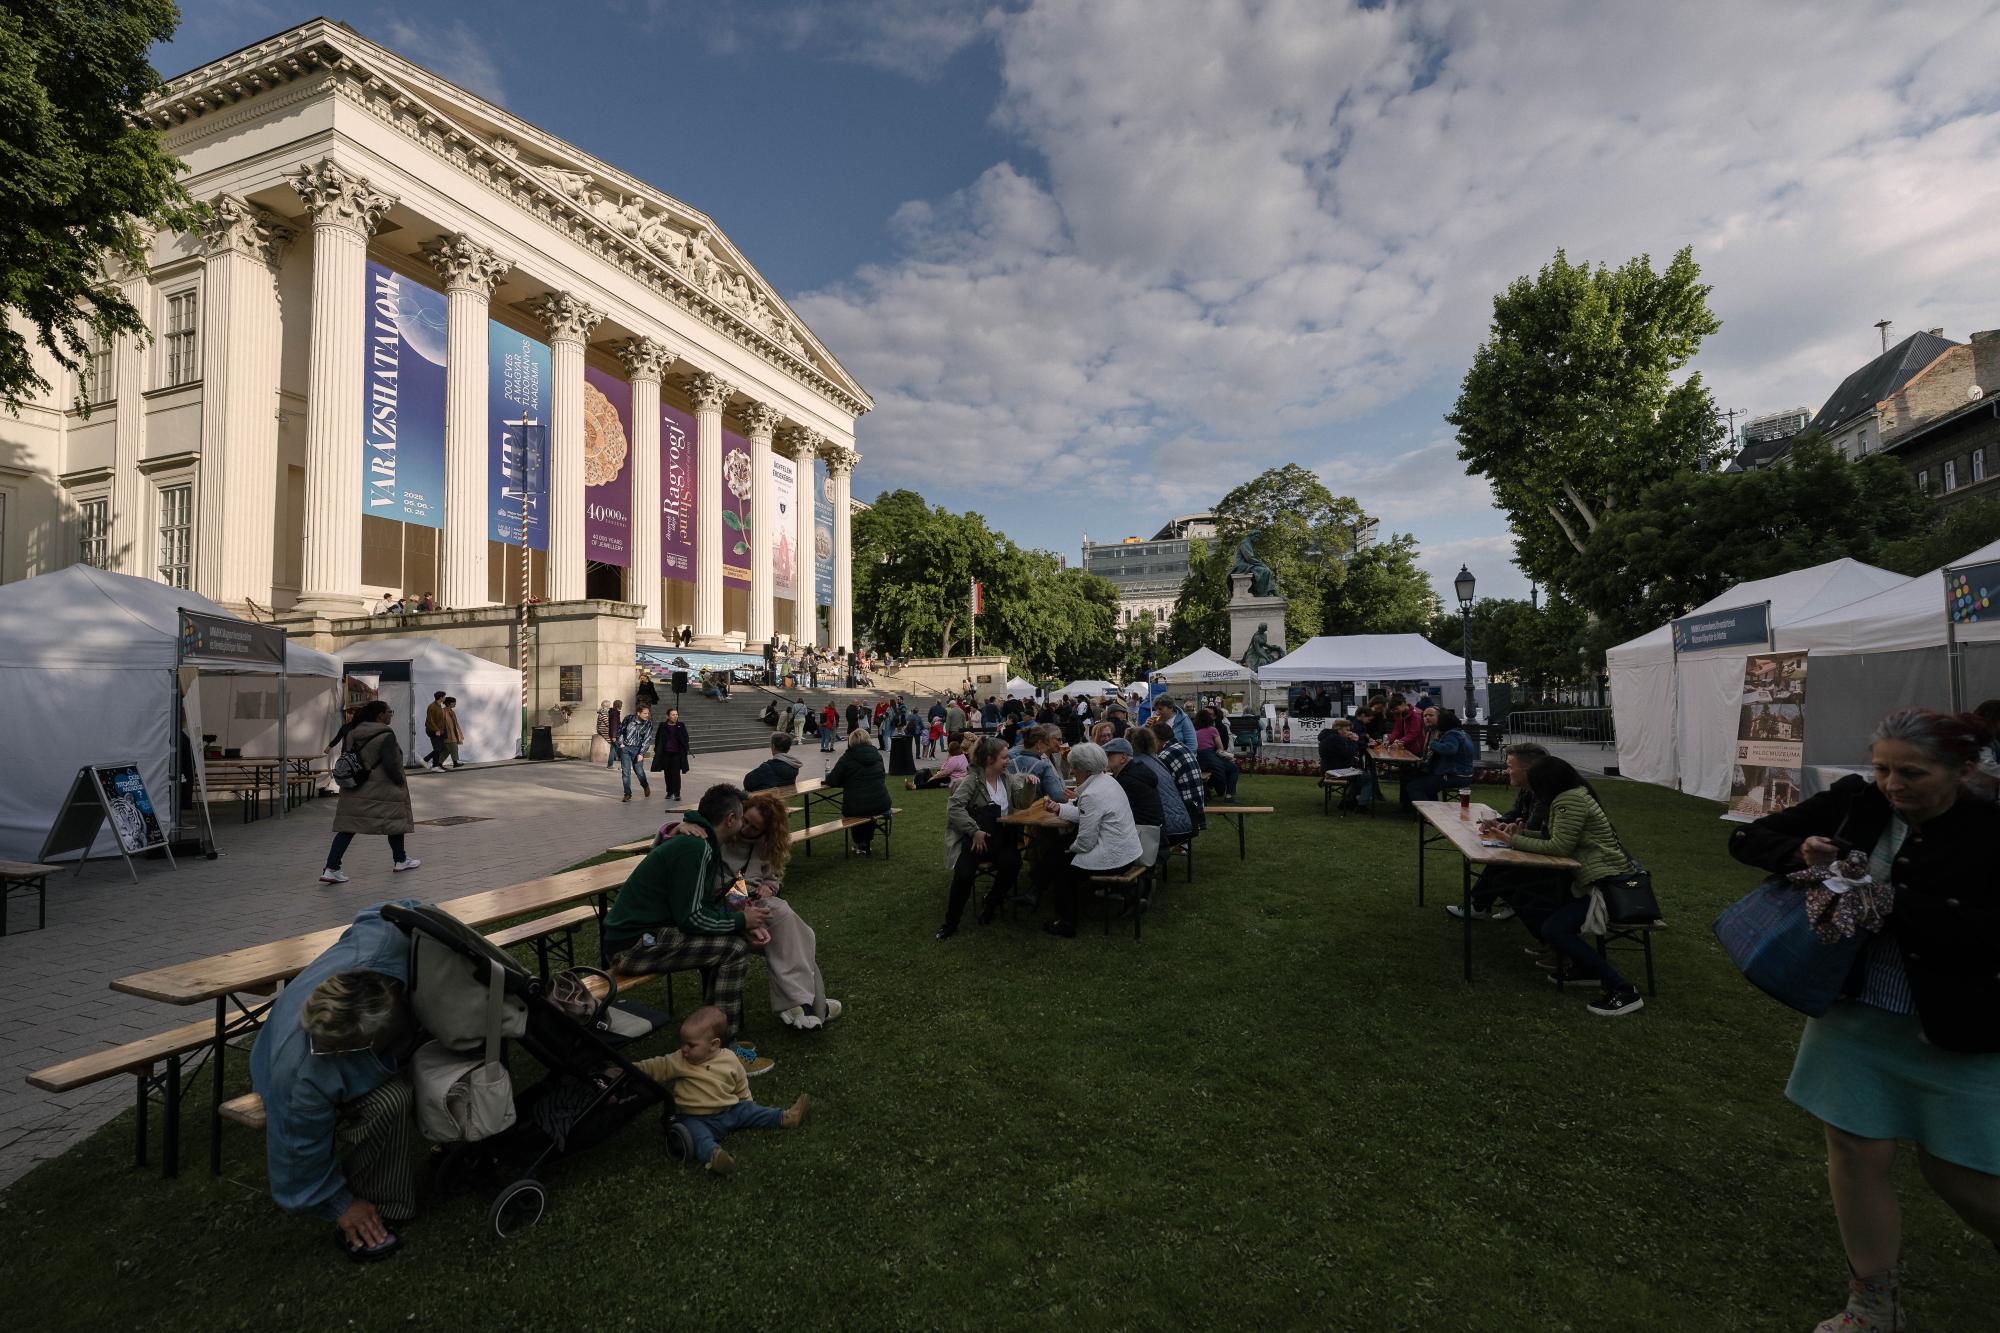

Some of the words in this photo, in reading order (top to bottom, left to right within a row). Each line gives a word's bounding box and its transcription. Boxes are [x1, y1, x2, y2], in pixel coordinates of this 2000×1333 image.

[504, 353, 513, 378] ÉVES
[367, 273, 400, 508] VARÁZSHATALOM
[504, 379, 513, 401] 200
[514, 397, 521, 405] A
[664, 416, 685, 517] Ragyogj!
[680, 489, 692, 546] Shine!
